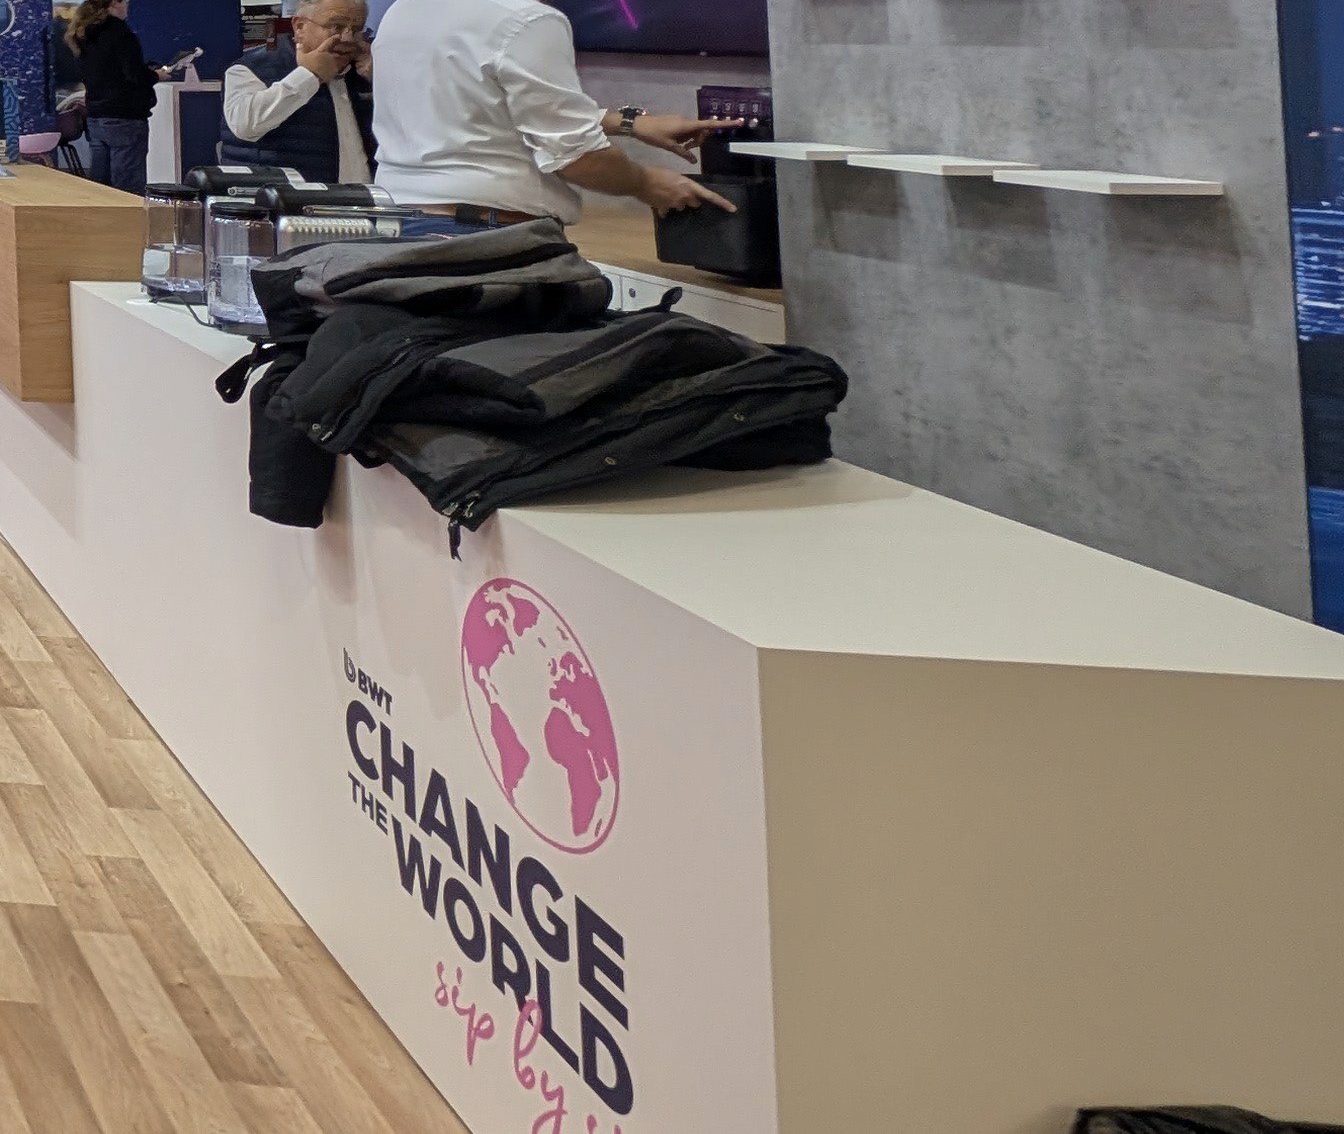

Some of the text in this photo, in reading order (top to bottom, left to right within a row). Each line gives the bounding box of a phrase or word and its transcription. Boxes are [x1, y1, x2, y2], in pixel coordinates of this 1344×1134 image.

[358, 668, 393, 716] BWT
[346, 699, 628, 1031] CHANGE
[348, 770, 634, 1115] THE WORLD
[434, 960, 495, 1066] sip
